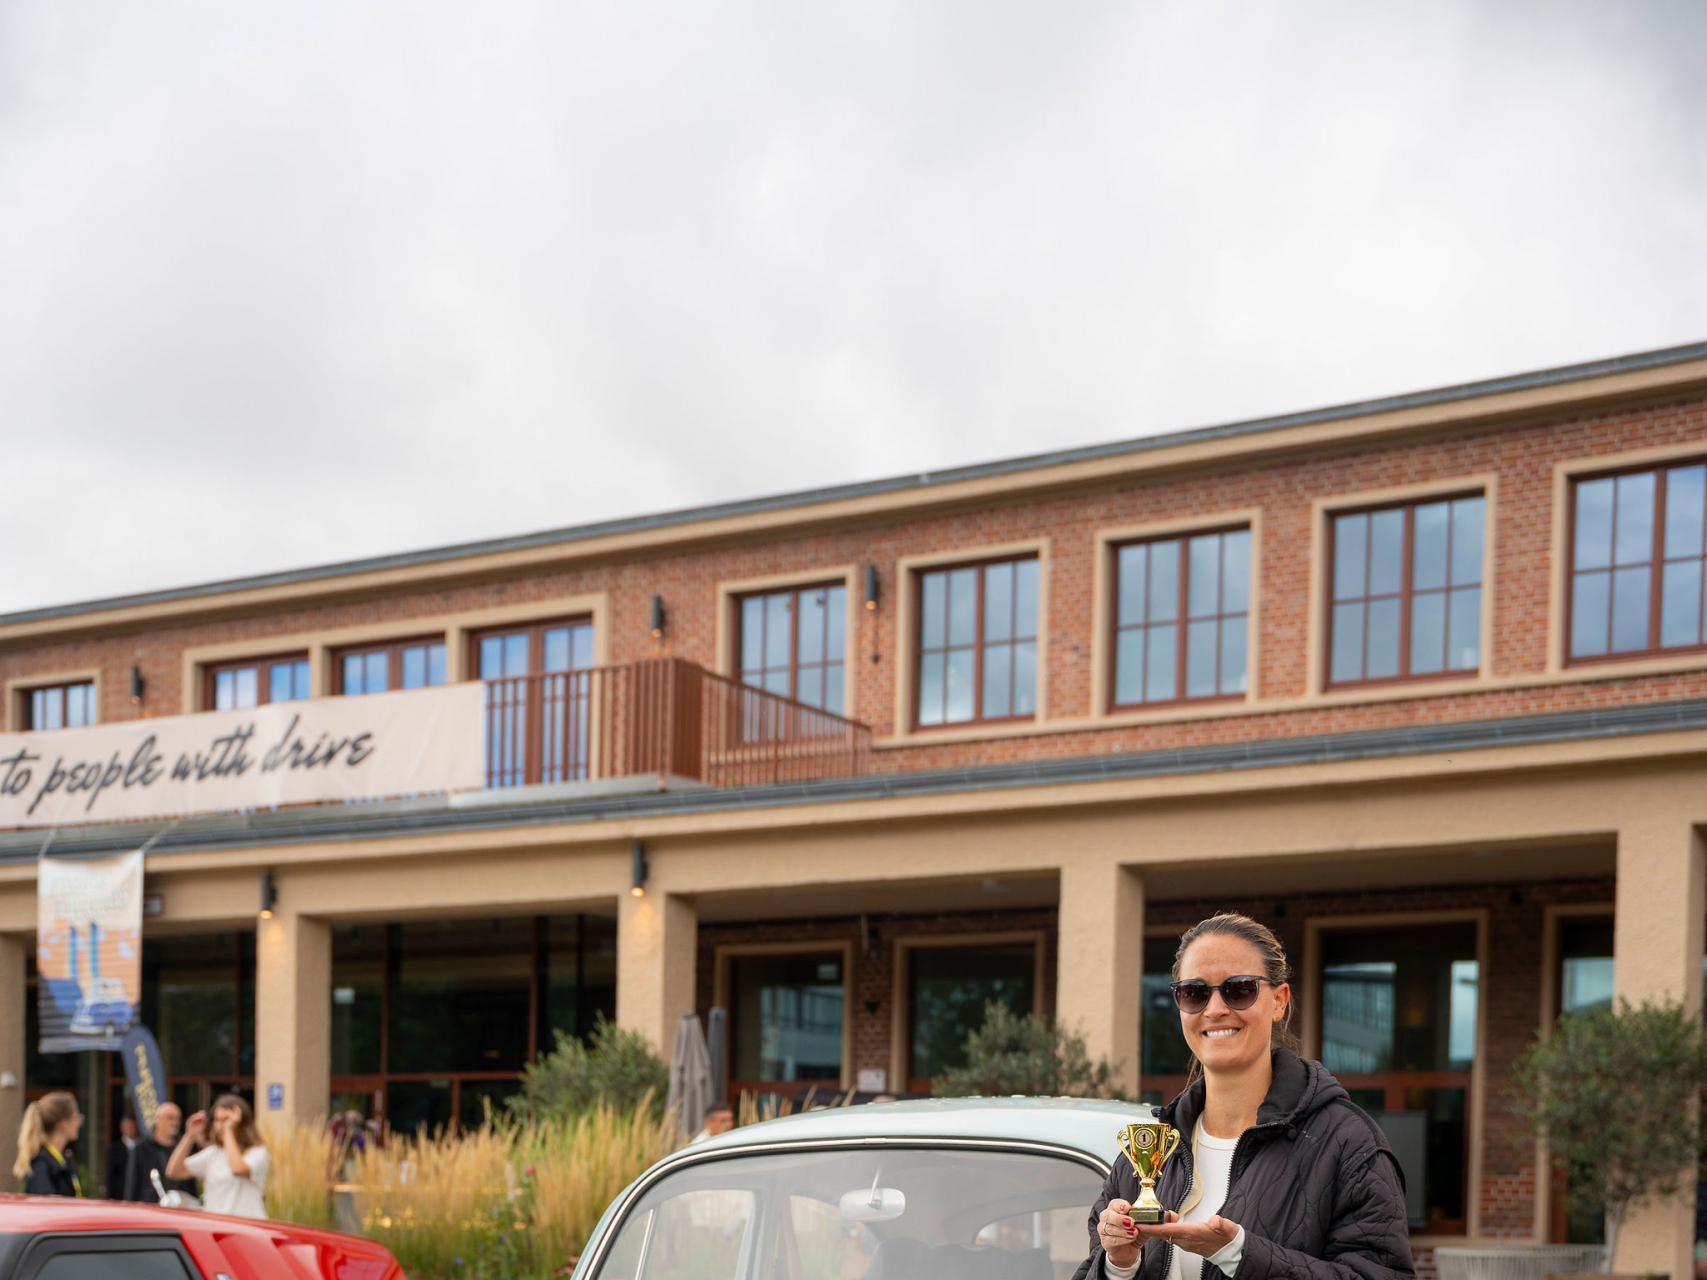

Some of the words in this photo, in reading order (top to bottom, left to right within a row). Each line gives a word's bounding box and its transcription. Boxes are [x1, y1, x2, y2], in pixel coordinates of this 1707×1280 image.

[0, 748, 41, 795] to
[28, 735, 164, 815] people
[169, 722, 257, 783] with
[261, 714, 374, 772] drive
